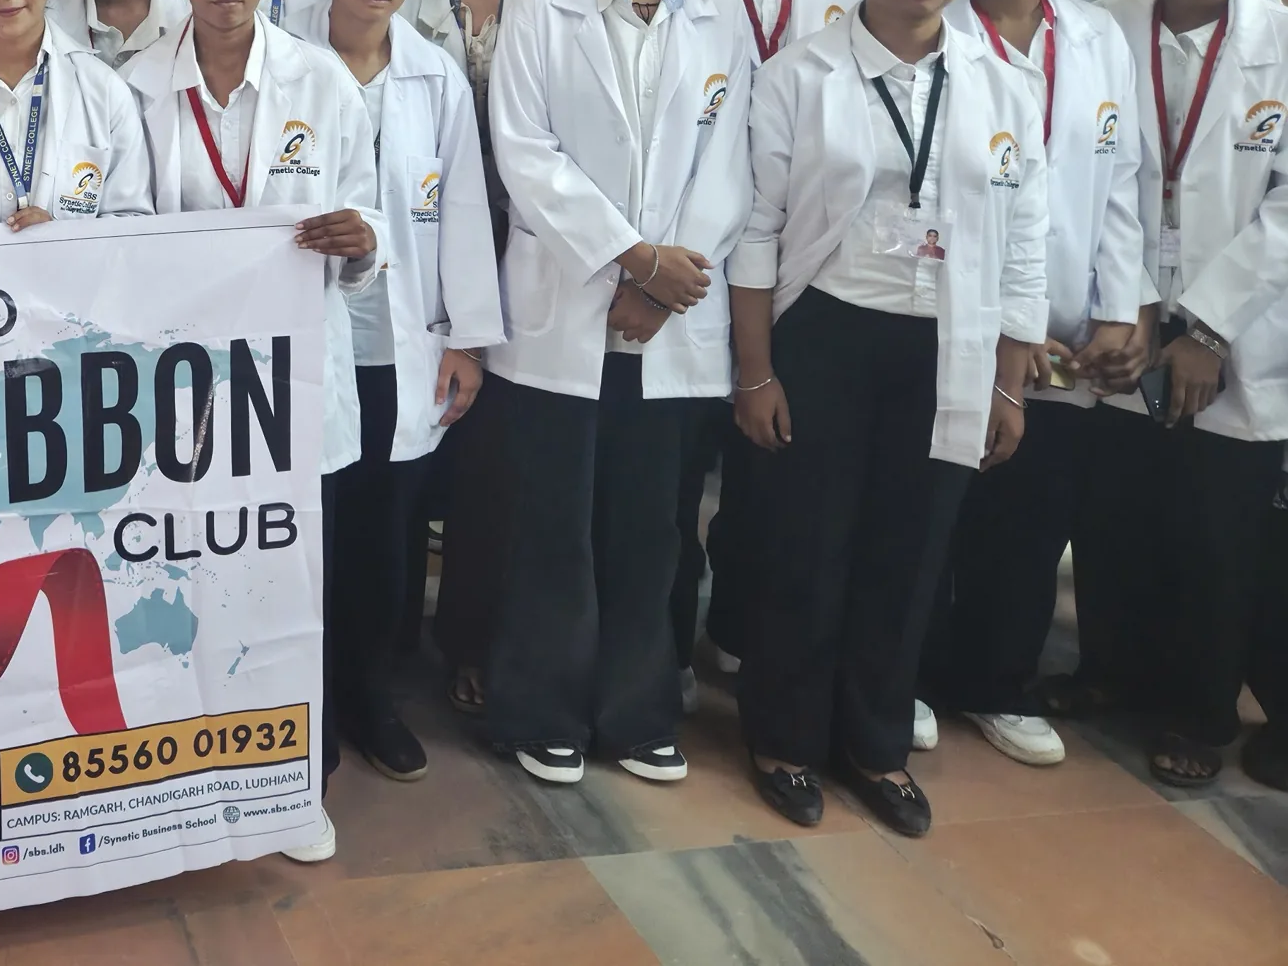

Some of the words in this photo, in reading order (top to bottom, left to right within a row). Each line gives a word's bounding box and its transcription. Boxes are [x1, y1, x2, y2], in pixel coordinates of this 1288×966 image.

[23, 146, 33, 181] SYNETIC
[29, 106, 39, 144] COLLEGE
[1234, 143, 1266, 152] Synetic
[4, 153, 21, 187] SYNETIC
[296, 167, 320, 176] College
[59, 197, 82, 206] Synetic
[84, 192, 97, 200] SBS
[113, 501, 298, 563] CLUB
[62, 736, 178, 782] 85560
[193, 718, 297, 758] 01932
[6, 810, 62, 830] CAMPUS:
[64, 800, 126, 822] RAMGARH,
[128, 786, 205, 810] CHANDIGARH
[208, 779, 244, 794] ROAD,
[245, 770, 304, 789] LUDHIANA
[243, 798, 312, 820] www.sbs.ac.in
[98, 829, 140, 848] /Synetic
[142, 821, 183, 839] Business
[185, 814, 218, 830] School
[22, 844, 66, 860] /sbs.ldh
